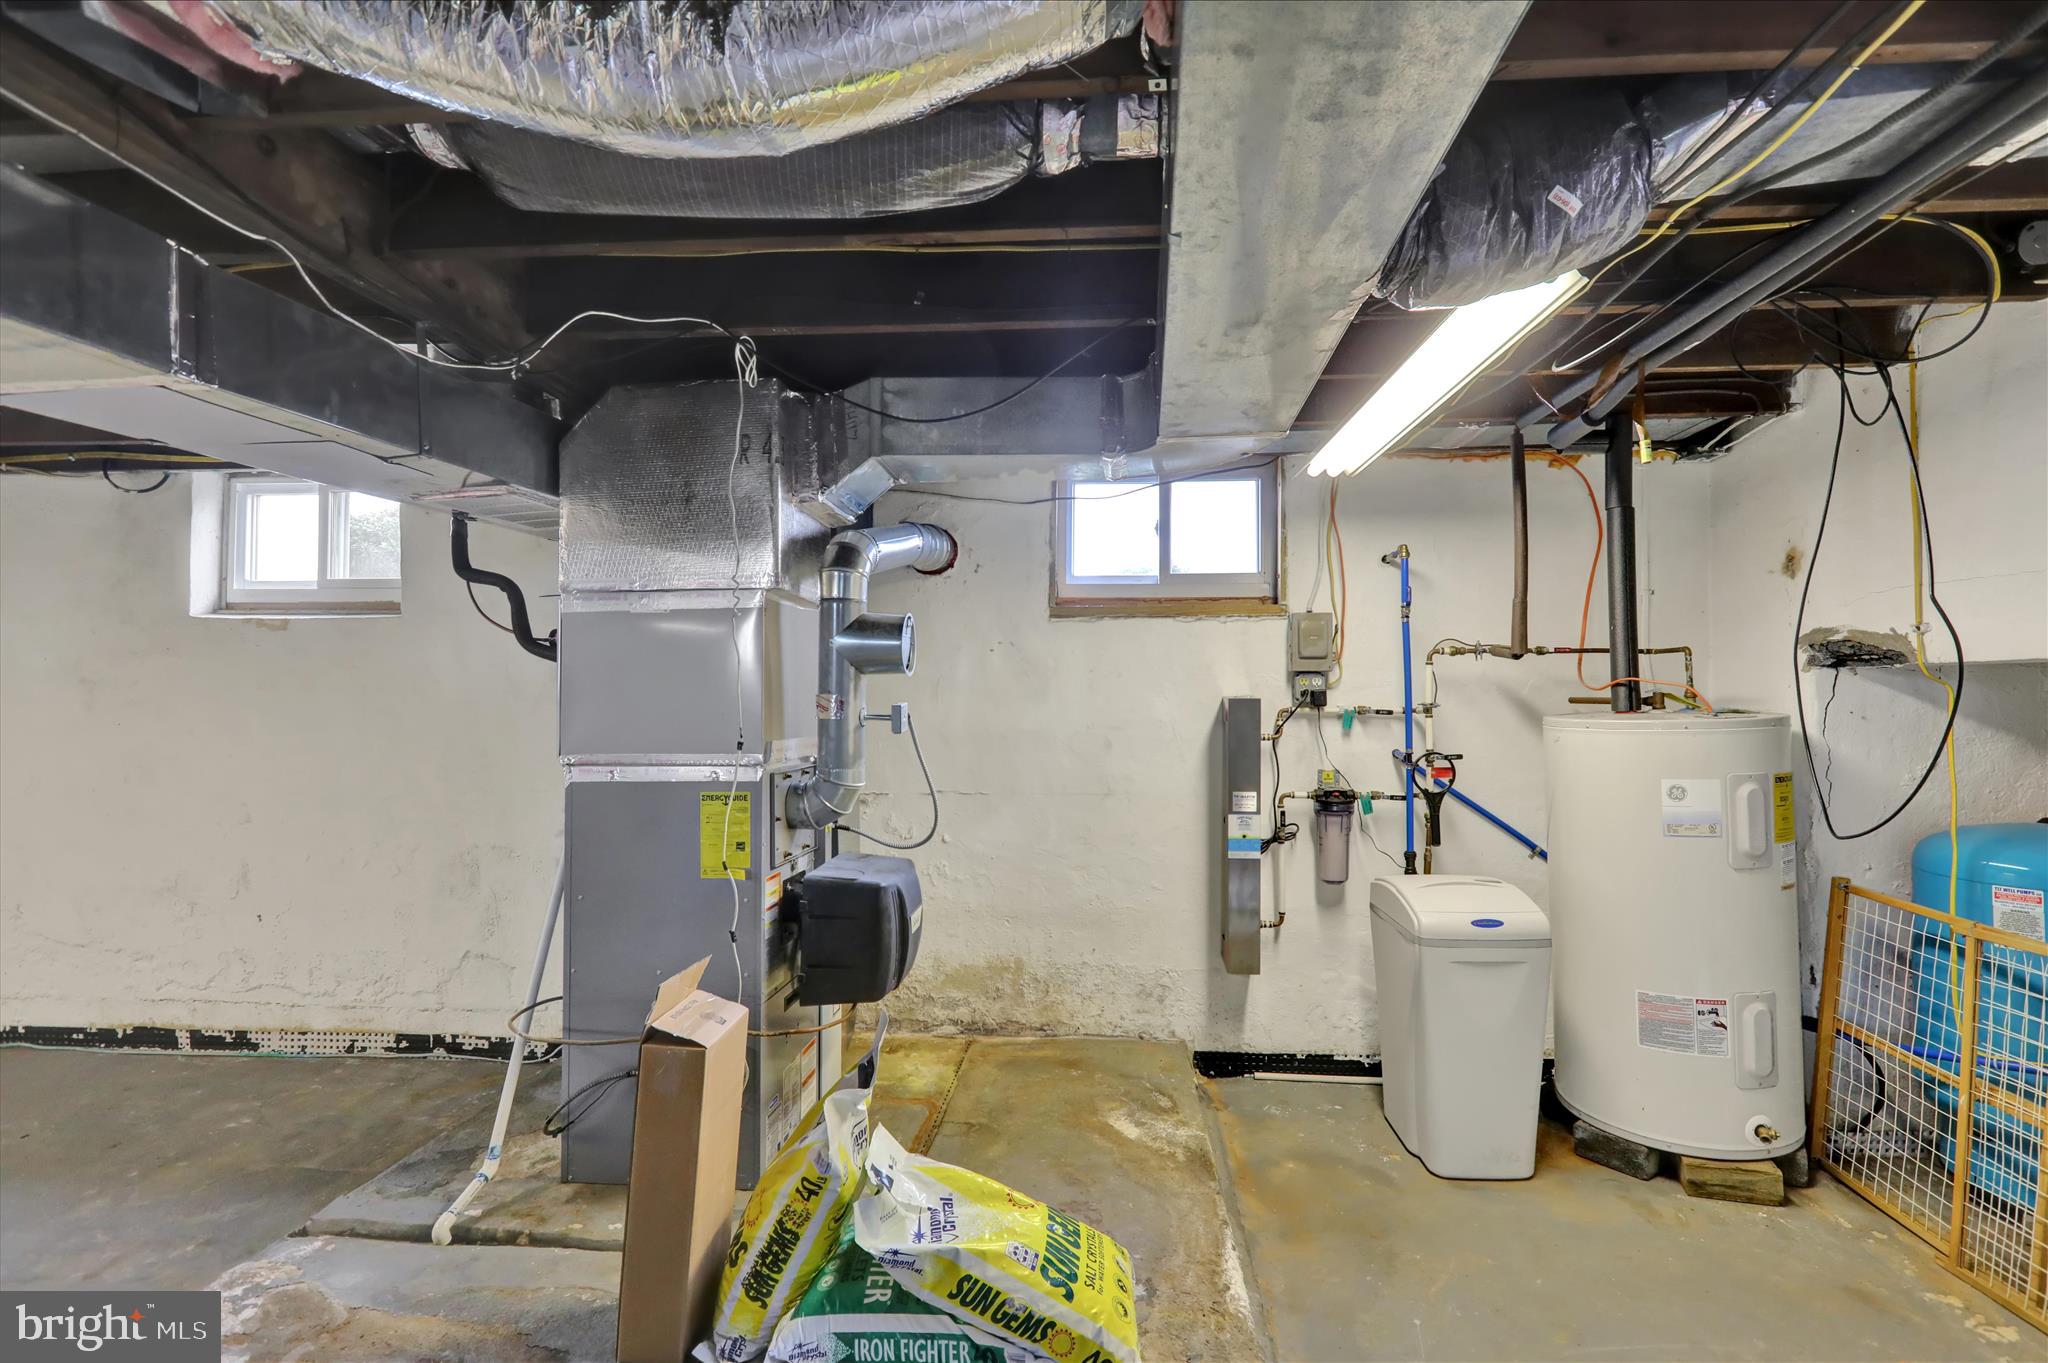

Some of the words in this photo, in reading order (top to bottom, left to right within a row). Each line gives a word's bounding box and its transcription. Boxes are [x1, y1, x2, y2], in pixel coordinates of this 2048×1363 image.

[740, 433, 751, 465] R
[1084, 1263, 1098, 1291] SALT
[854, 1338, 894, 1362] IRON
[901, 1338, 971, 1363] FIGHTER
